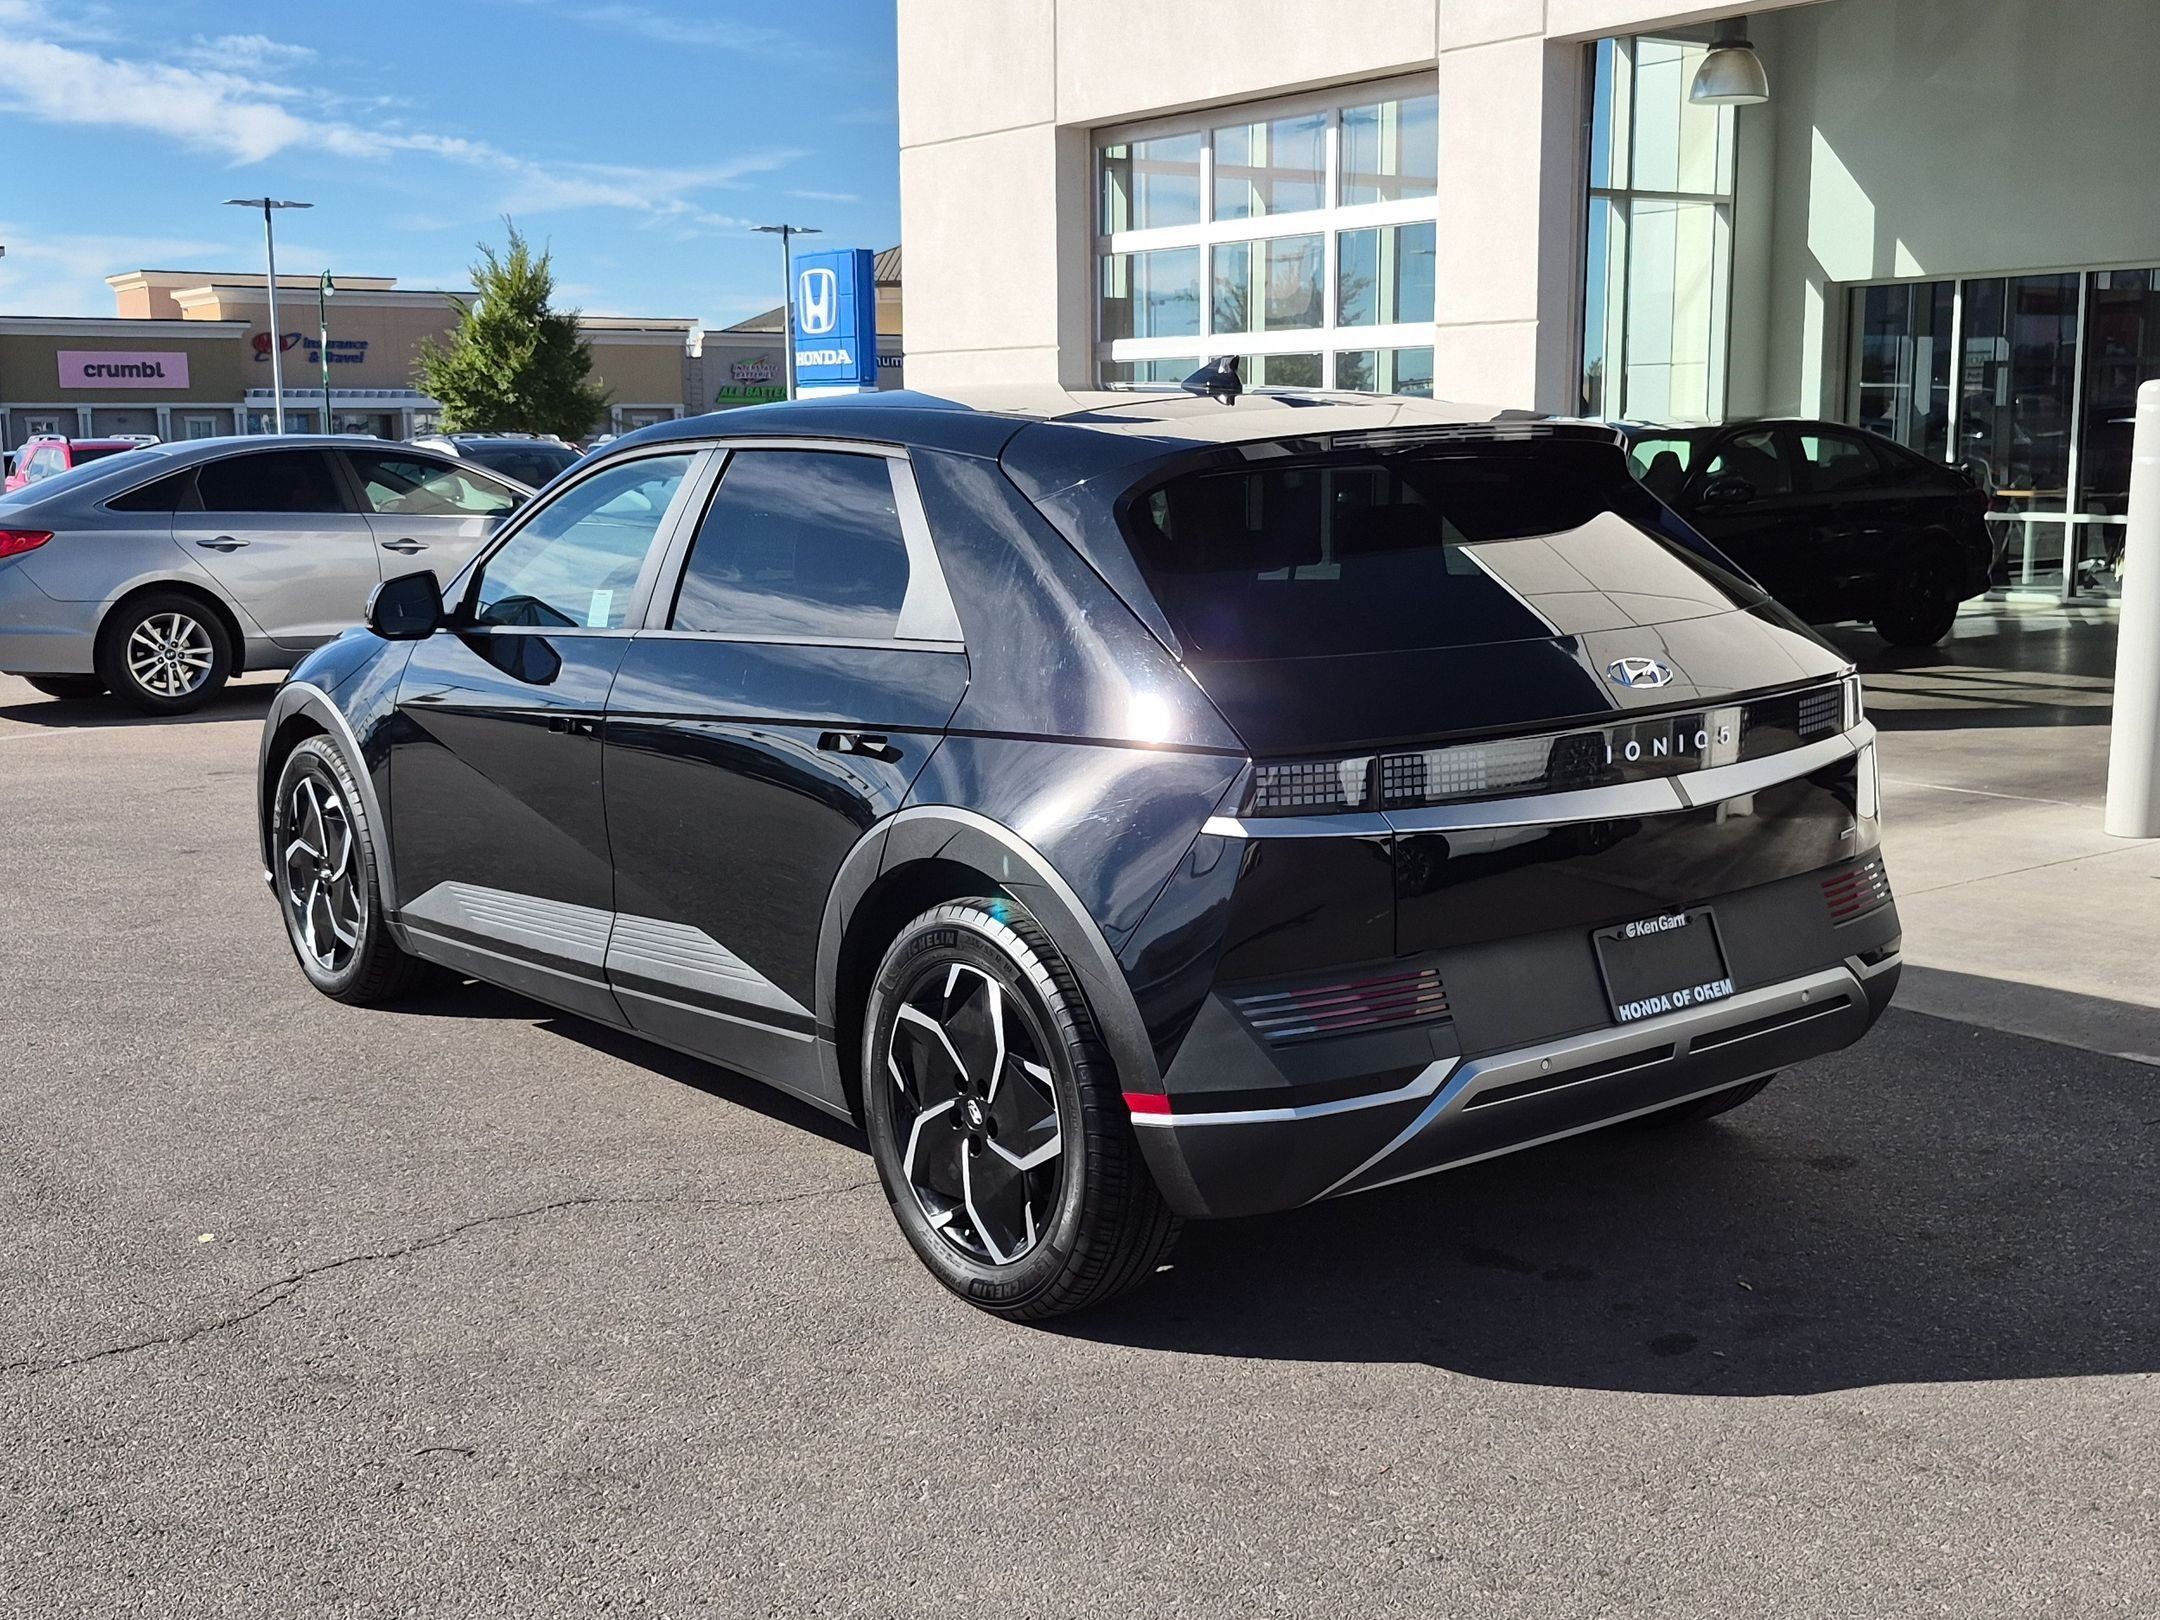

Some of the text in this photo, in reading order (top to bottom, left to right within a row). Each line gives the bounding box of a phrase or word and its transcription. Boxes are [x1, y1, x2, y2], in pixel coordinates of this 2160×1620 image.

[796, 349, 852, 366] HONDA
[83, 361, 165, 378] crumbl
[721, 386, 743, 397] ALL
[1718, 725, 1730, 745] 5
[1618, 978, 1734, 1021] HONDA OF OREM
